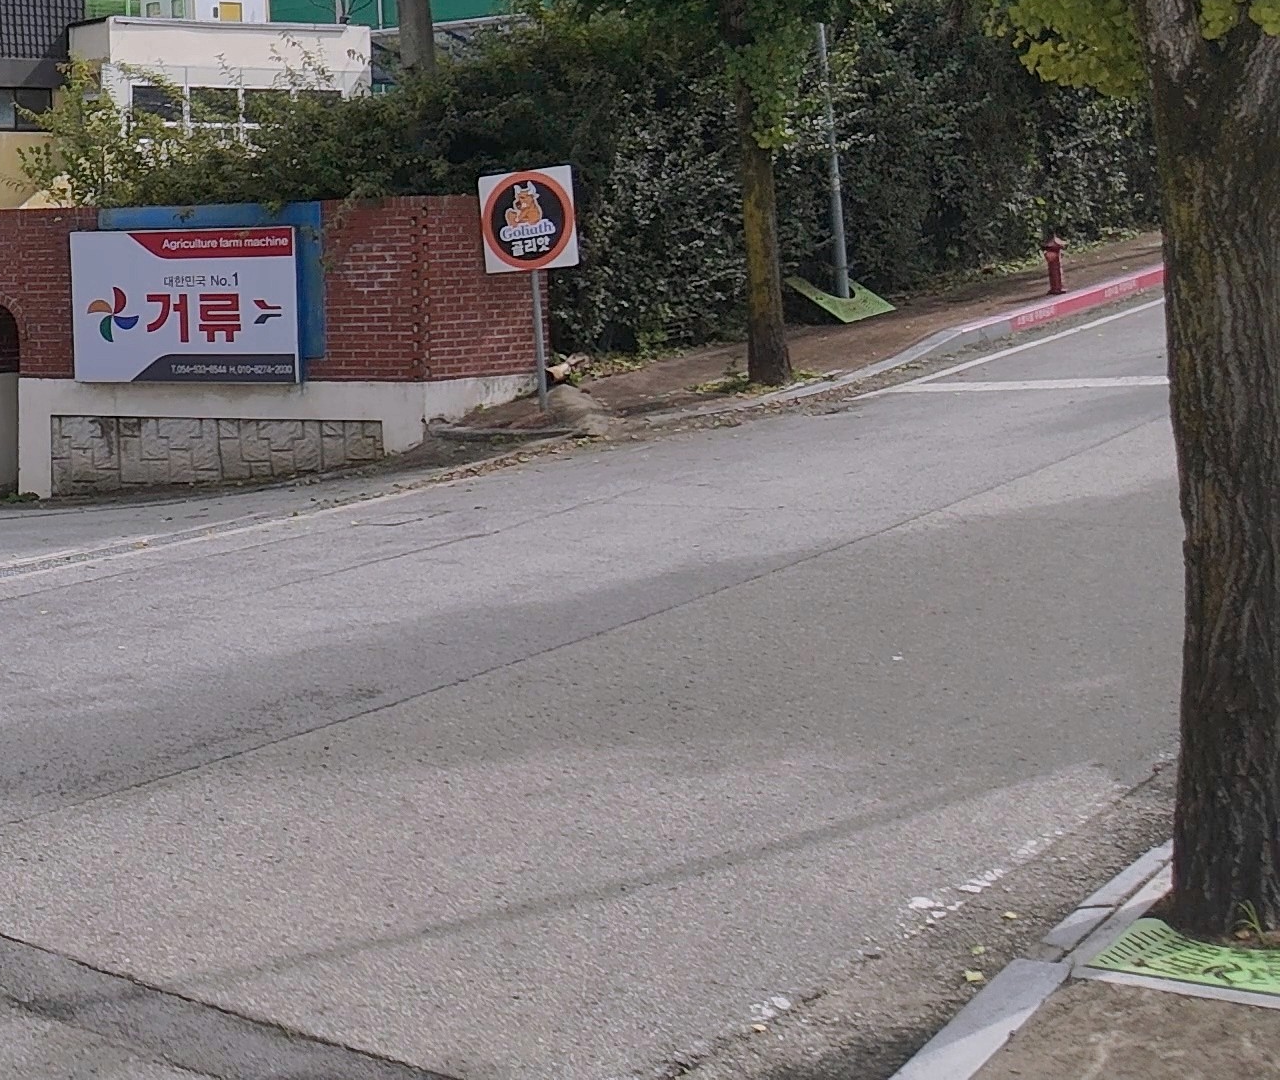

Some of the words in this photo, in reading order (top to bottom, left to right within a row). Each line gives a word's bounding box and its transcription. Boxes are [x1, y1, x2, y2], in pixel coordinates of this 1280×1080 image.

[502, 221, 552, 239] Goliath
[162, 238, 217, 251] Agriculture
[219, 237, 241, 248] farm
[244, 236, 289, 247] machine
[511, 235, 550, 257] 골리앗
[163, 275, 206, 288] 대한민국
[210, 272, 239, 287] No.1
[146, 293, 241, 343] 거류
